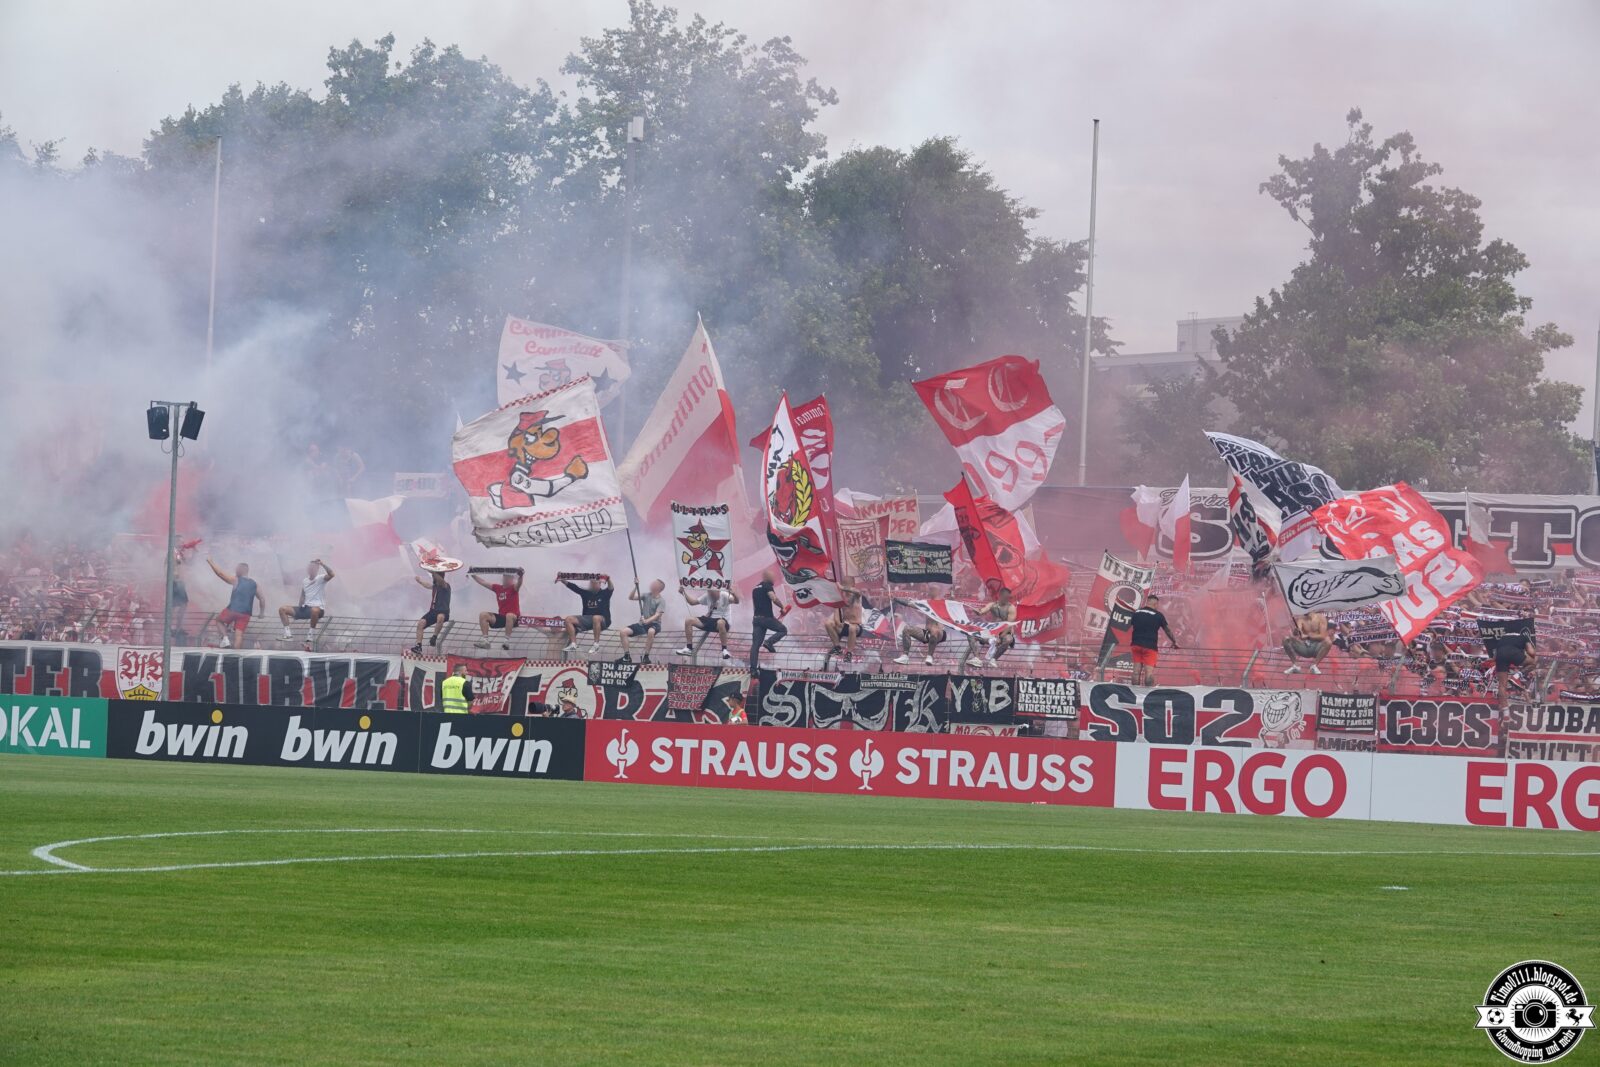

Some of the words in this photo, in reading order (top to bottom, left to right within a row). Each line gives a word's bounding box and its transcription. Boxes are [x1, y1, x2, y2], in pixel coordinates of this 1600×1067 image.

[671, 503, 729, 517] ULTRAS
[180, 652, 393, 710] KURVE
[602, 662, 615, 671] DU
[1018, 693, 1076, 706] BEDEUTET
[1019, 680, 1076, 696] ULTRAS
[1321, 696, 1354, 708] KAMPF
[1017, 703, 1077, 715] WIDERSTAND
[1321, 707, 1357, 718] EINSATZ
[135, 709, 249, 759] bwin
[280, 715, 398, 765] bwin
[430, 722, 553, 774] bwin
[650, 737, 838, 782] STRAUSS
[895, 747, 1094, 794] STRAUSS
[1147, 747, 1347, 818] ERGO
